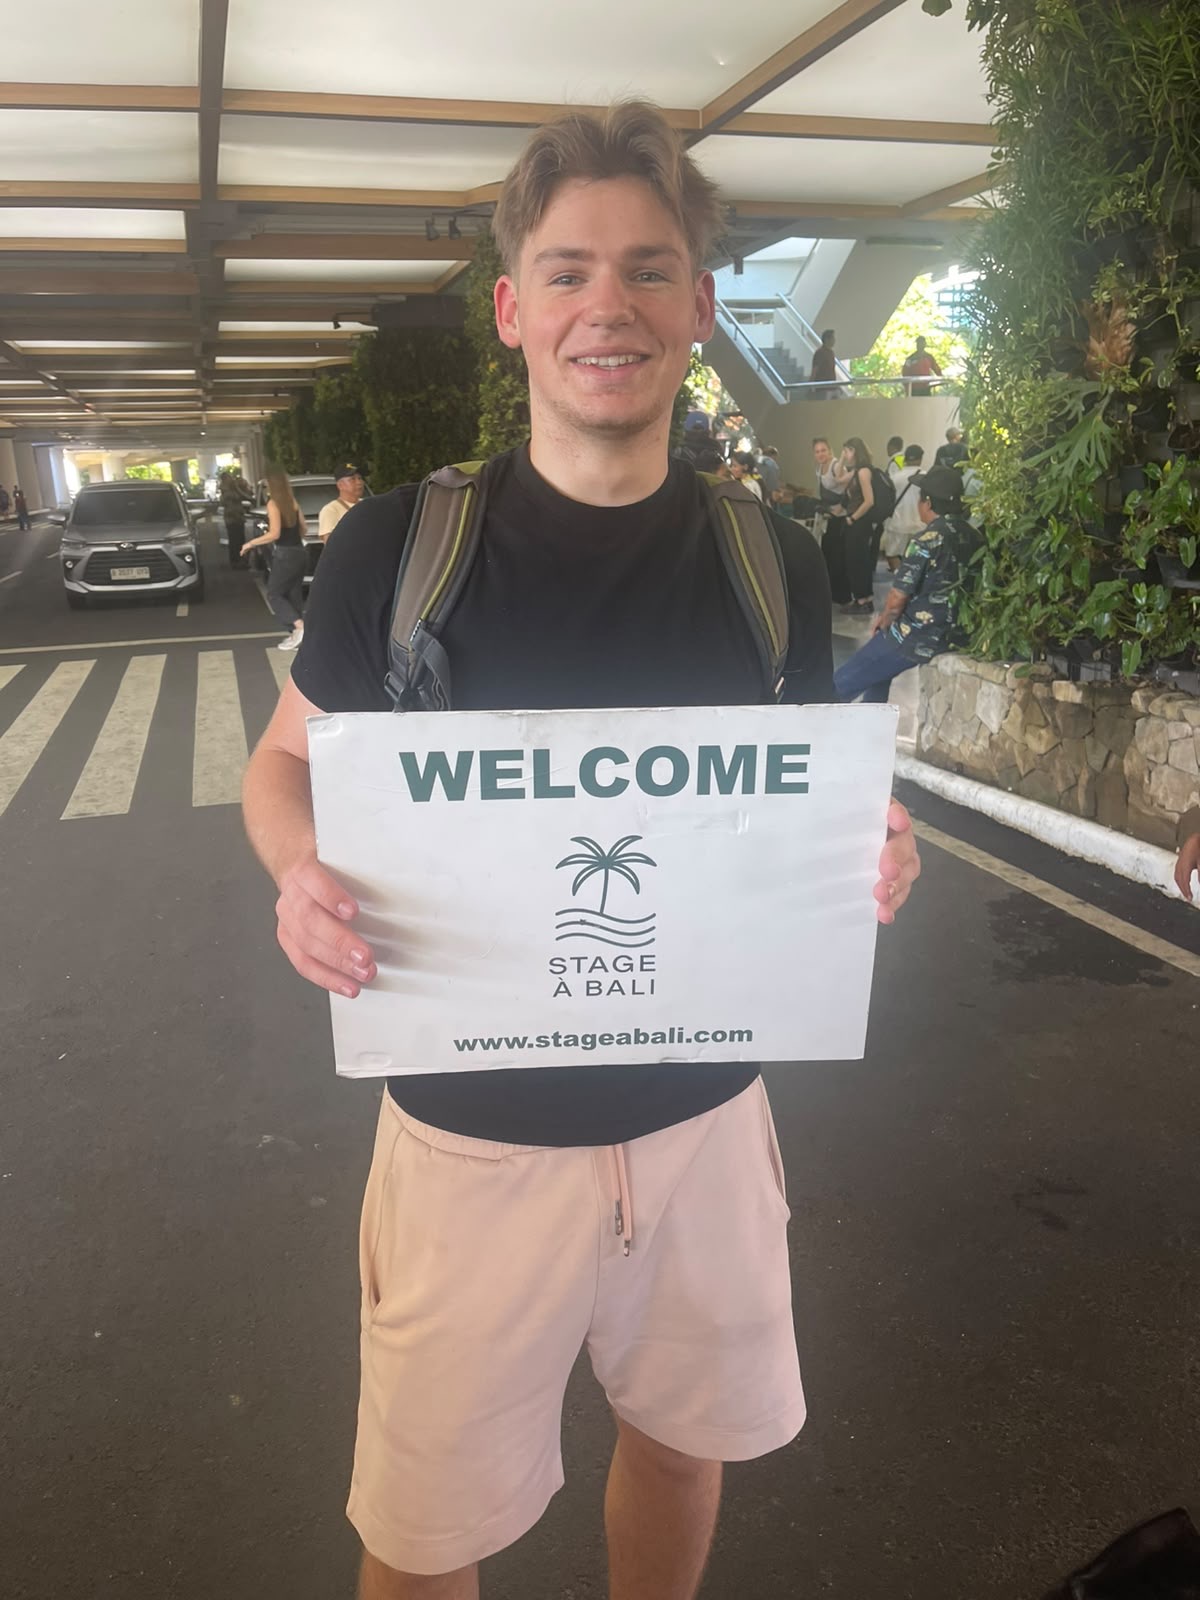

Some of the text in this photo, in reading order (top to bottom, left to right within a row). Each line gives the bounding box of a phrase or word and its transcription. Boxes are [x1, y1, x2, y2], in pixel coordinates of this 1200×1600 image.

[399, 743, 811, 803] WELCOME
[548, 954, 656, 975] STAGE
[552, 976, 655, 998] À BALI
[453, 1026, 753, 1052] www.stageabali.com
